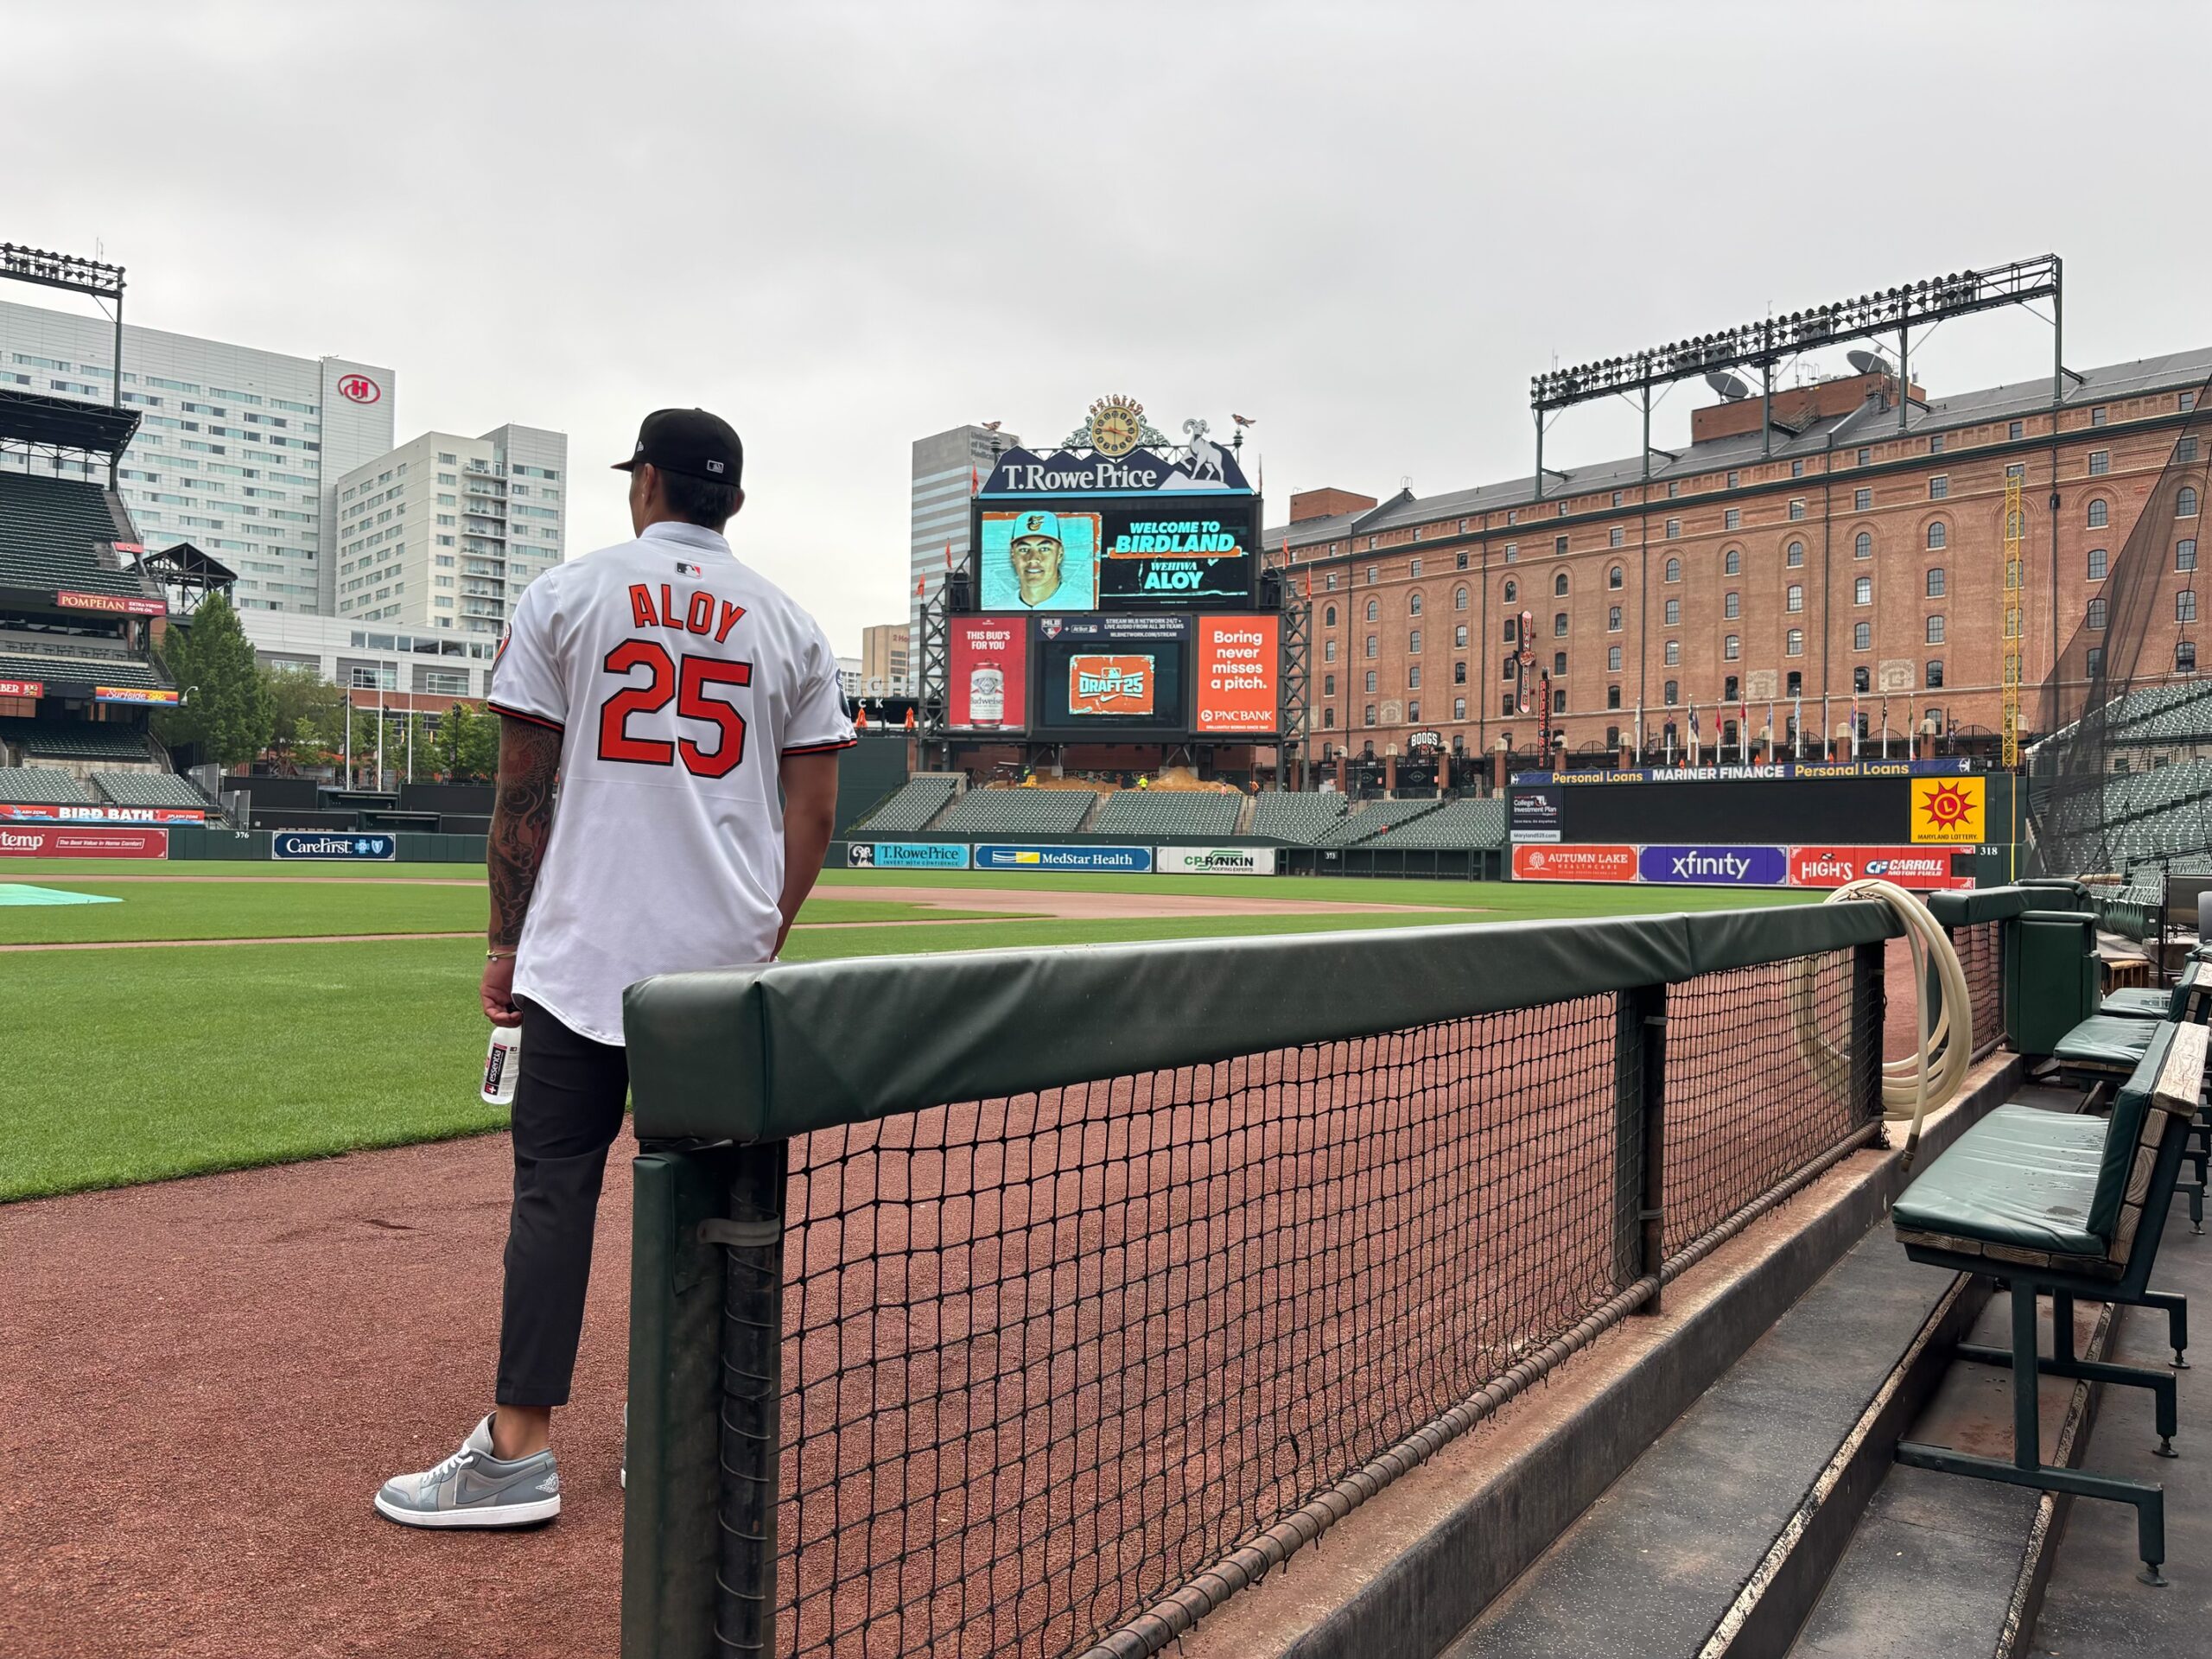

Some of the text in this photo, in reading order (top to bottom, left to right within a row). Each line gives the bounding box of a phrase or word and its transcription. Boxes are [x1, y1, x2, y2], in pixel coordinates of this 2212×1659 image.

[1130, 521, 1221, 534] WELCOME TO
[1116, 534, 1235, 553] BIRDLAND
[1151, 562, 1198, 571] WEHIWA
[1144, 571, 1204, 589] ALOY
[61, 596, 124, 610] POMPEIAN
[628, 584, 747, 644] ALOY
[967, 631, 1010, 639] THIS BUD'S
[1214, 630, 1262, 645] Boring
[971, 641, 1005, 650] FOR YOU
[1217, 648, 1260, 658] never
[1212, 661, 1263, 673] misses
[1079, 677, 1143, 693] DRAFT 25
[1211, 676, 1268, 691] a pitch.
[106, 688, 147, 700] Surfside
[597, 638, 753, 779] 25
[1215, 710, 1272, 721] PNC BANK
[1652, 765, 1784, 781] MARINER FINANCE
[1795, 762, 1910, 777] Personal Loans
[1553, 771, 1643, 784] Personal Loans
[59, 807, 154, 821] BIRD BATH
[0, 831, 43, 850] temp
[286, 837, 353, 854] CareFirst
[1980, 847, 1998, 855] 318
[1042, 853, 1133, 865] MedStar Health
[1548, 854, 1628, 863] AUTUMN LAKE
[1671, 850, 1751, 880] xfinity
[1889, 859, 1942, 871] CARROLL
[1802, 861, 1853, 880] HIGH'S
[489, 1049, 501, 1082] essentia
